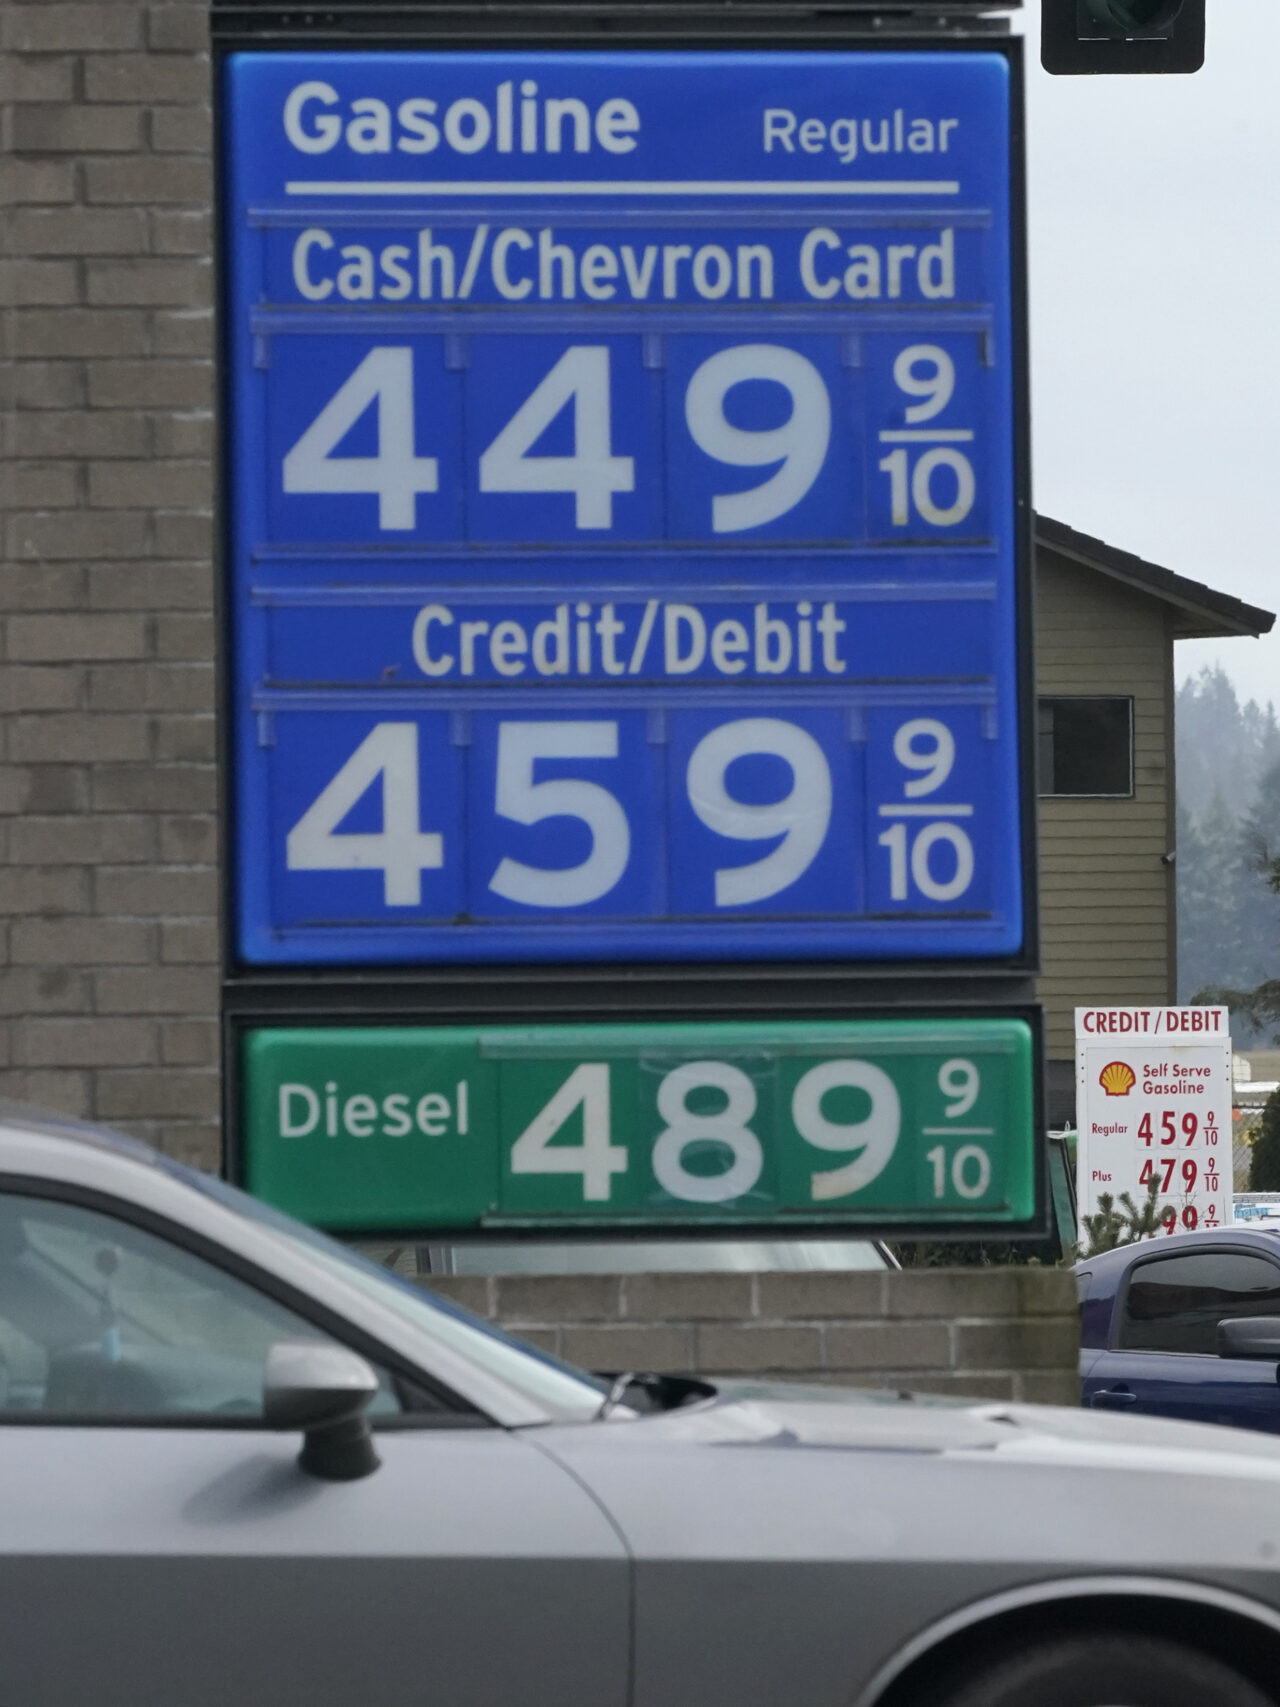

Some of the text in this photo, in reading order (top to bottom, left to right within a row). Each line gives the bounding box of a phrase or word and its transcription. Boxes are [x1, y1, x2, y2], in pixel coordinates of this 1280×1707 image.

[283, 80, 959, 164] Gasoline Regular
[292, 224, 955, 300] Cash/Chevron Card
[282, 344, 832, 533] 449
[412, 599, 847, 677] Credit/Debit
[286, 718, 833, 907] 459
[1143, 1063, 1211, 1077] Self Serve
[1143, 1080, 1204, 1095] Gasoline
[278, 1080, 469, 1138] Diesel
[510, 1060, 901, 1203] 489
[1091, 1122, 1129, 1136] Regular
[1137, 1111, 1198, 1147] 459
[1092, 1170, 1112, 1182] Plus
